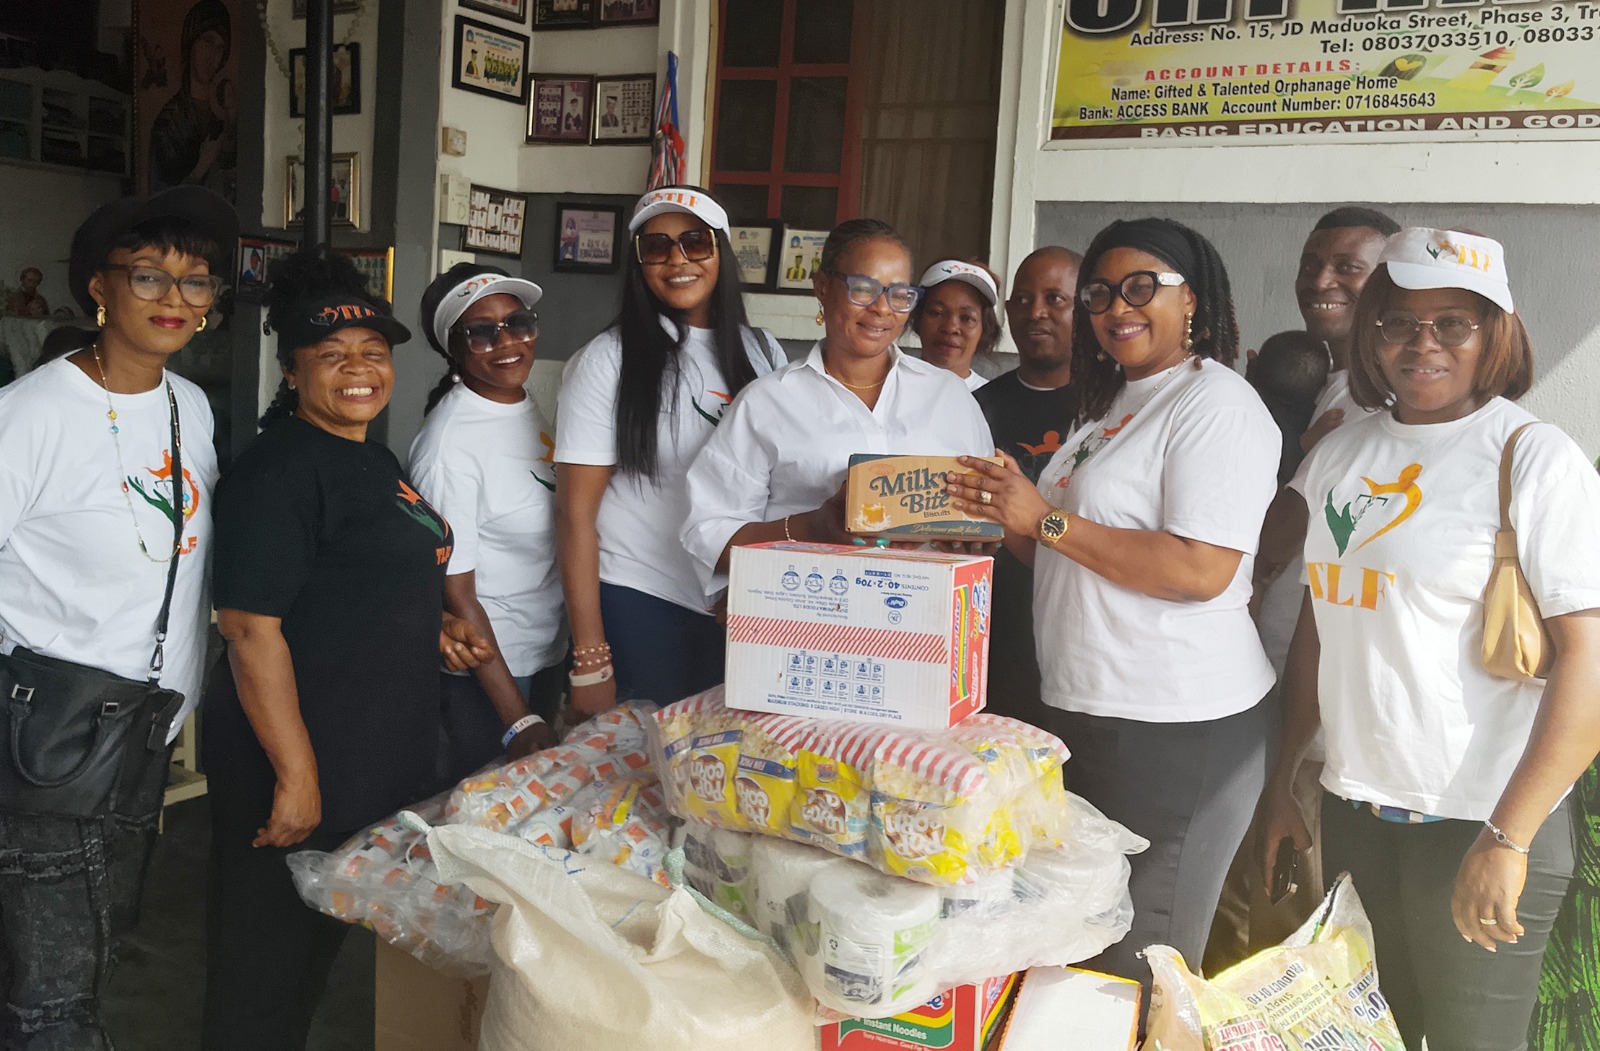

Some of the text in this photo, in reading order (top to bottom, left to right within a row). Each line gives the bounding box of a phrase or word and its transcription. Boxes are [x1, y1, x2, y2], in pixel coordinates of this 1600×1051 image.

[1130, 31, 1204, 46] Address:
[1211, 26, 1241, 41] No.
[1250, 24, 1275, 40] 15,
[1281, 21, 1304, 37] JD
[1310, 15, 1400, 34] Maduoka
[1408, 13, 1473, 30] Street,
[1481, 8, 1543, 26] Phase
[1551, 7, 1570, 23] 3,
[1320, 39, 1354, 54] Tel:
[1362, 31, 1515, 51] 08037033510,
[1145, 59, 1360, 81] ACCOUNT DETAILS:
[1111, 76, 1398, 101] Name: Gifted & Talented Orphanage Home
[1079, 92, 1436, 120] Bank: ACCESS BANK Account Number: 0716845643
[1140, 126, 1230, 138] BASIC
[1238, 118, 1426, 137] EDUCATION
[1437, 115, 1511, 131] AND
[179, 536, 198, 556] LF
[855, 577, 873, 587] 70g
[877, 580, 884, 588] 2
[887, 582, 900, 590] 40
[1306, 562, 1395, 611] TLF
[894, 831, 946, 857] POP
[1269, 962, 1305, 995] PRODUCT
[1265, 991, 1294, 1013] SIMPLY
[863, 1018, 928, 1040] Instant Noodles
[1220, 1023, 1252, 1041] WEIGHT
